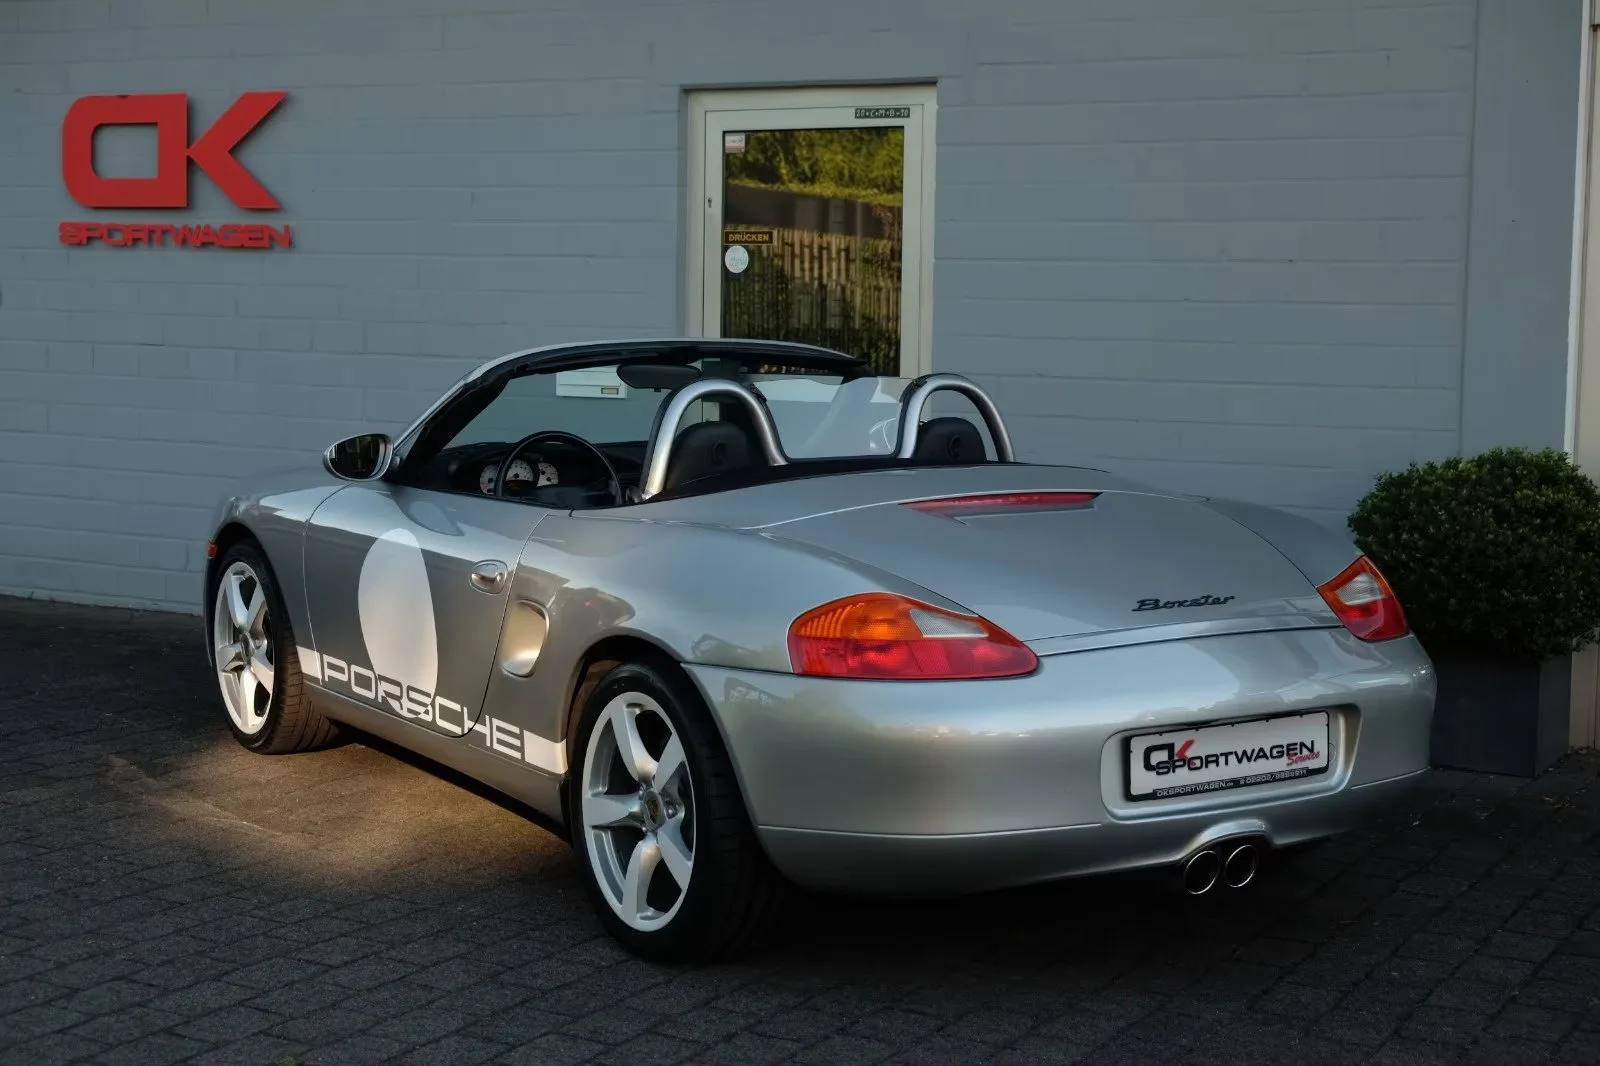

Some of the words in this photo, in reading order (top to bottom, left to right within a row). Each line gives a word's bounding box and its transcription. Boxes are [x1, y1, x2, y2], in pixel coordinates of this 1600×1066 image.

[59, 221, 293, 249] SPORTWAGEN
[728, 232, 770, 242] DRÜCKEN
[1131, 594, 1235, 612] Boxster
[322, 653, 522, 760] PORSCHE
[1155, 740, 1315, 776] SPORTWAGEN
